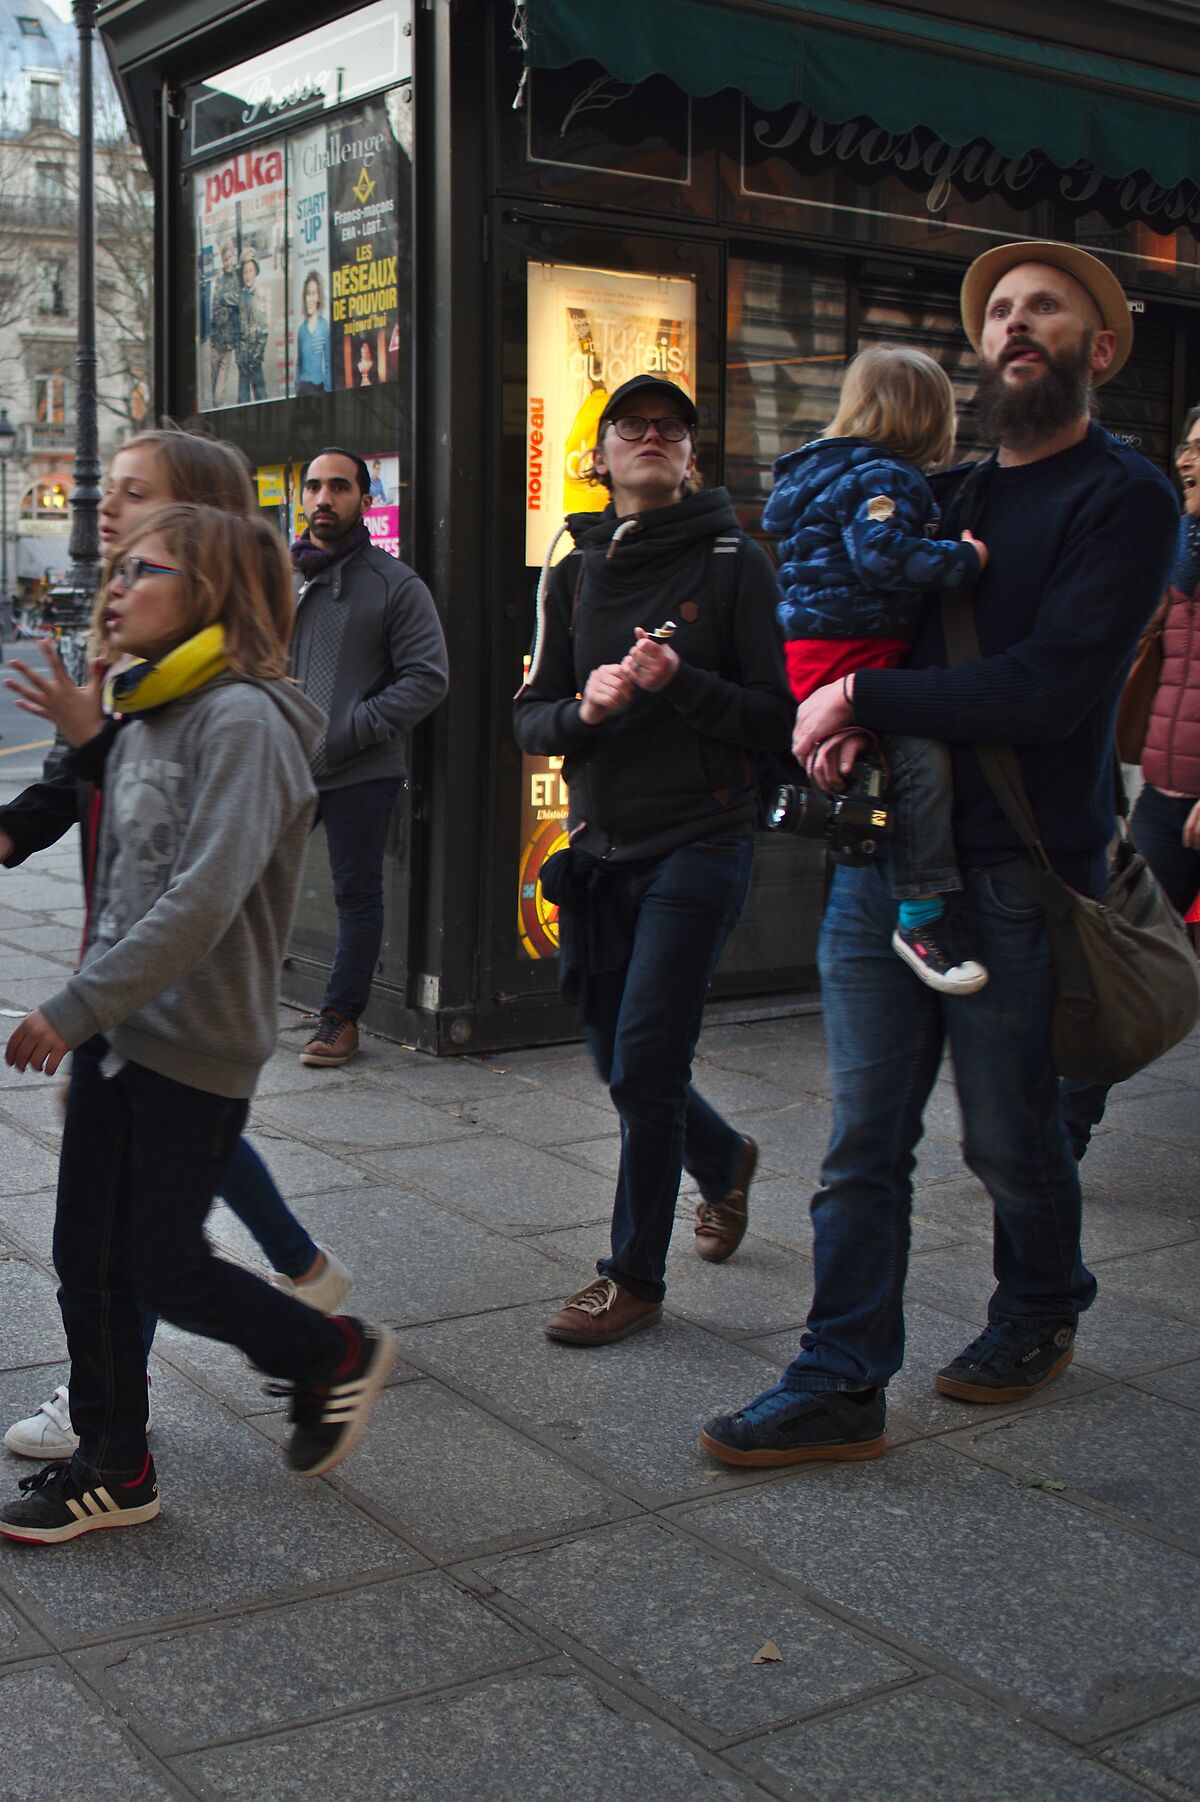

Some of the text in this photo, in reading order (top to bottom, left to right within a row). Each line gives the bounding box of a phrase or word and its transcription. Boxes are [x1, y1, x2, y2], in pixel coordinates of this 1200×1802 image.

[302, 130, 392, 178] Challenge
[204, 151, 283, 214] polka
[296, 191, 326, 220] START
[356, 243, 373, 263] LES
[332, 256, 398, 298] RÉSEAUX
[333, 287, 398, 321] DE POUVOIR
[527, 397, 545, 511] nouveau
[531, 773, 556, 807] ET
